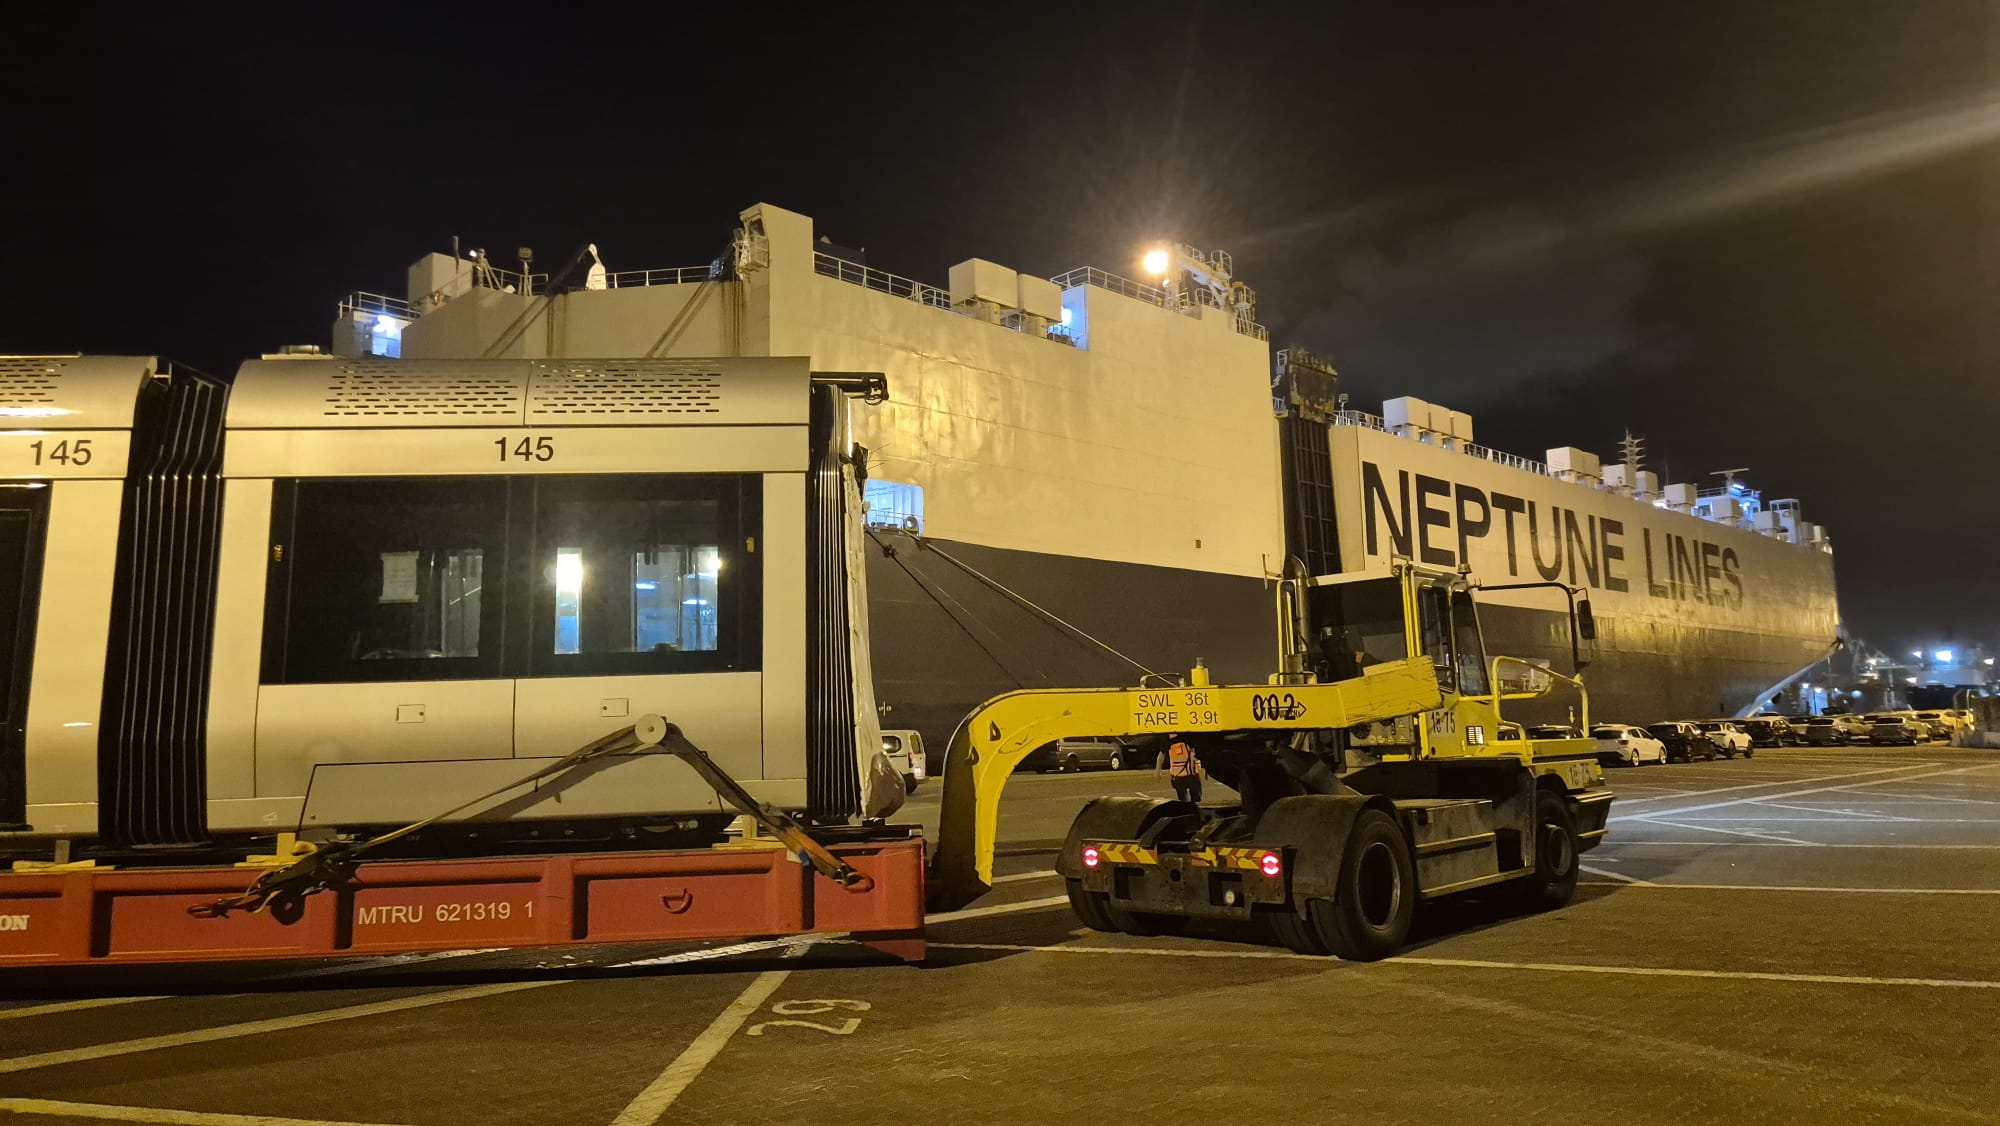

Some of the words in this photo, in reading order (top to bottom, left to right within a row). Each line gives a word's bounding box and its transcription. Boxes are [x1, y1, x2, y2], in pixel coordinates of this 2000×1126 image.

[29, 439, 92, 466] 145
[494, 436, 554, 462] 145
[1361, 460, 1629, 593] NEPTUNE
[1643, 527, 1744, 611] LINES
[1138, 693, 1175, 708] SWL
[1184, 692, 1210, 706] 36t
[1133, 711, 1179, 726] TARE
[1189, 710, 1218, 726] 3,9t
[357, 905, 423, 925] MTRU
[435, 901, 511, 922] 621319
[524, 900, 533, 918] 1
[746, 999, 872, 1036] 29
